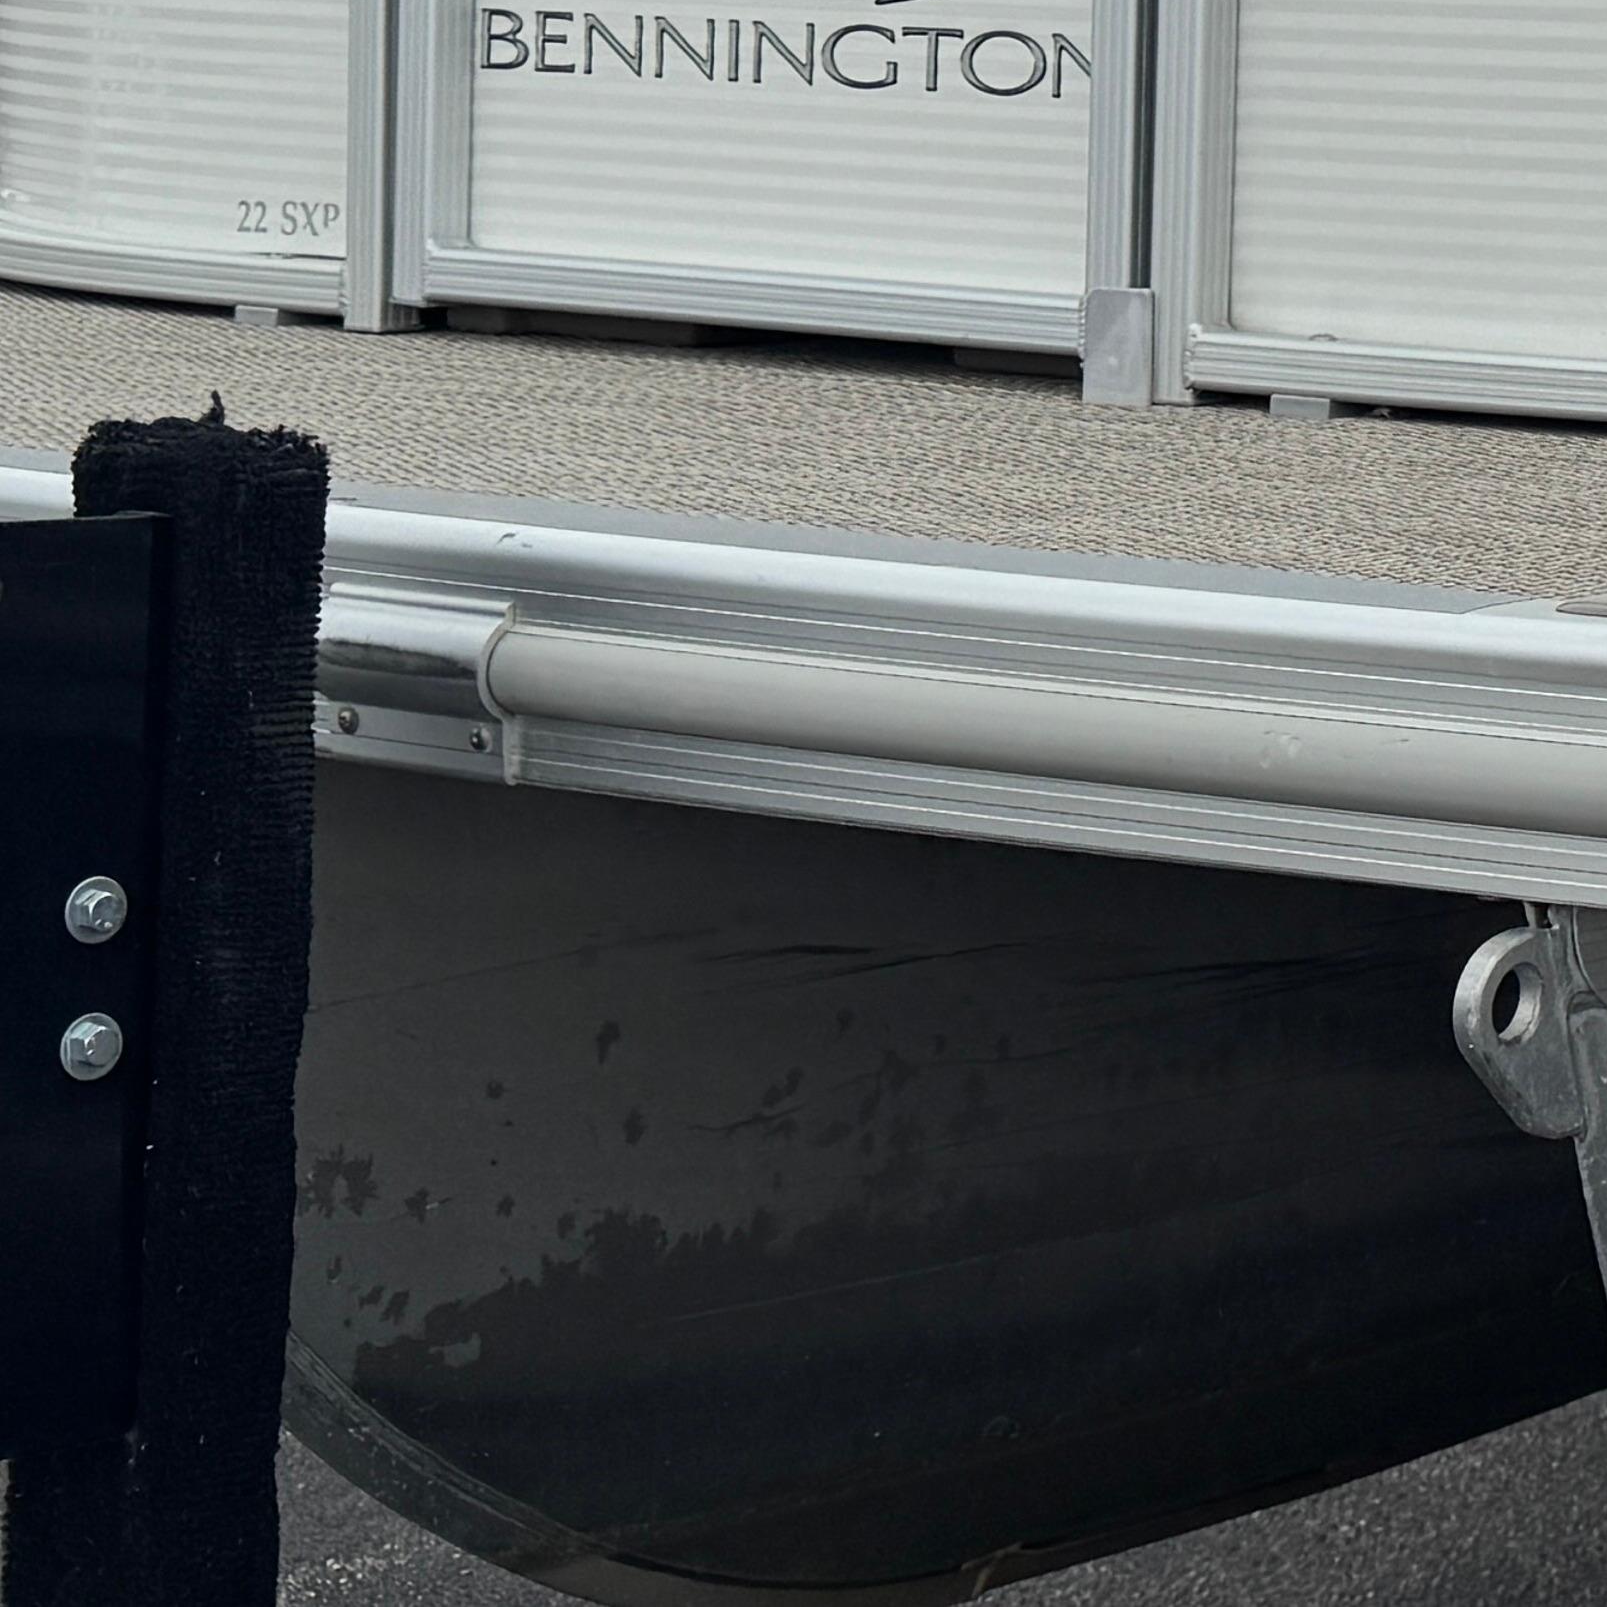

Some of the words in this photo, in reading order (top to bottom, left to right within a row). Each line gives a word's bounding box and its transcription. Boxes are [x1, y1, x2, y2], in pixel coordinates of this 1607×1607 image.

[480, 7, 1092, 98] BENNINGTON
[236, 200, 268, 233] 22
[281, 200, 341, 236] SXP
